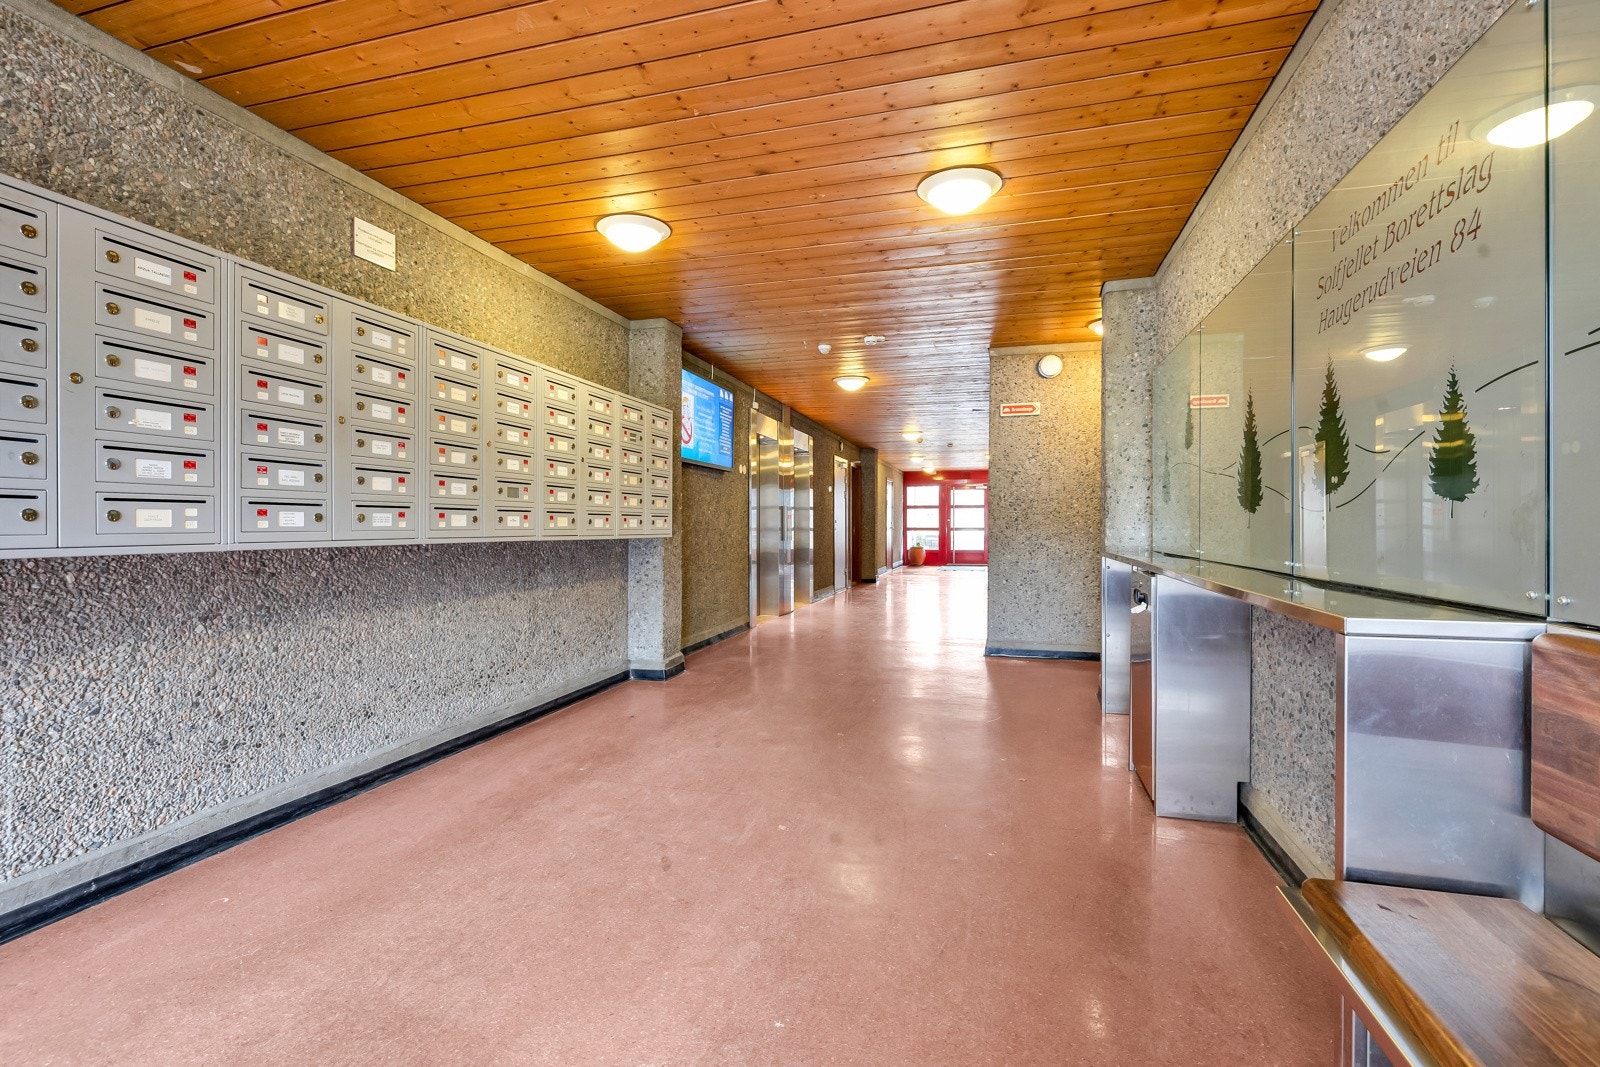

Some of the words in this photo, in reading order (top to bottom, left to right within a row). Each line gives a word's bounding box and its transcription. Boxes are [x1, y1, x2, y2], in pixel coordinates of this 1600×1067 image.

[1316, 234, 1379, 300] Solfjellet
[1383, 150, 1495, 253] Borettslag
[1332, 153, 1429, 252] Velkommen
[1437, 119, 1460, 166] til
[1318, 239, 1442, 334] Haugerudveien
[1450, 206, 1482, 253] 84
